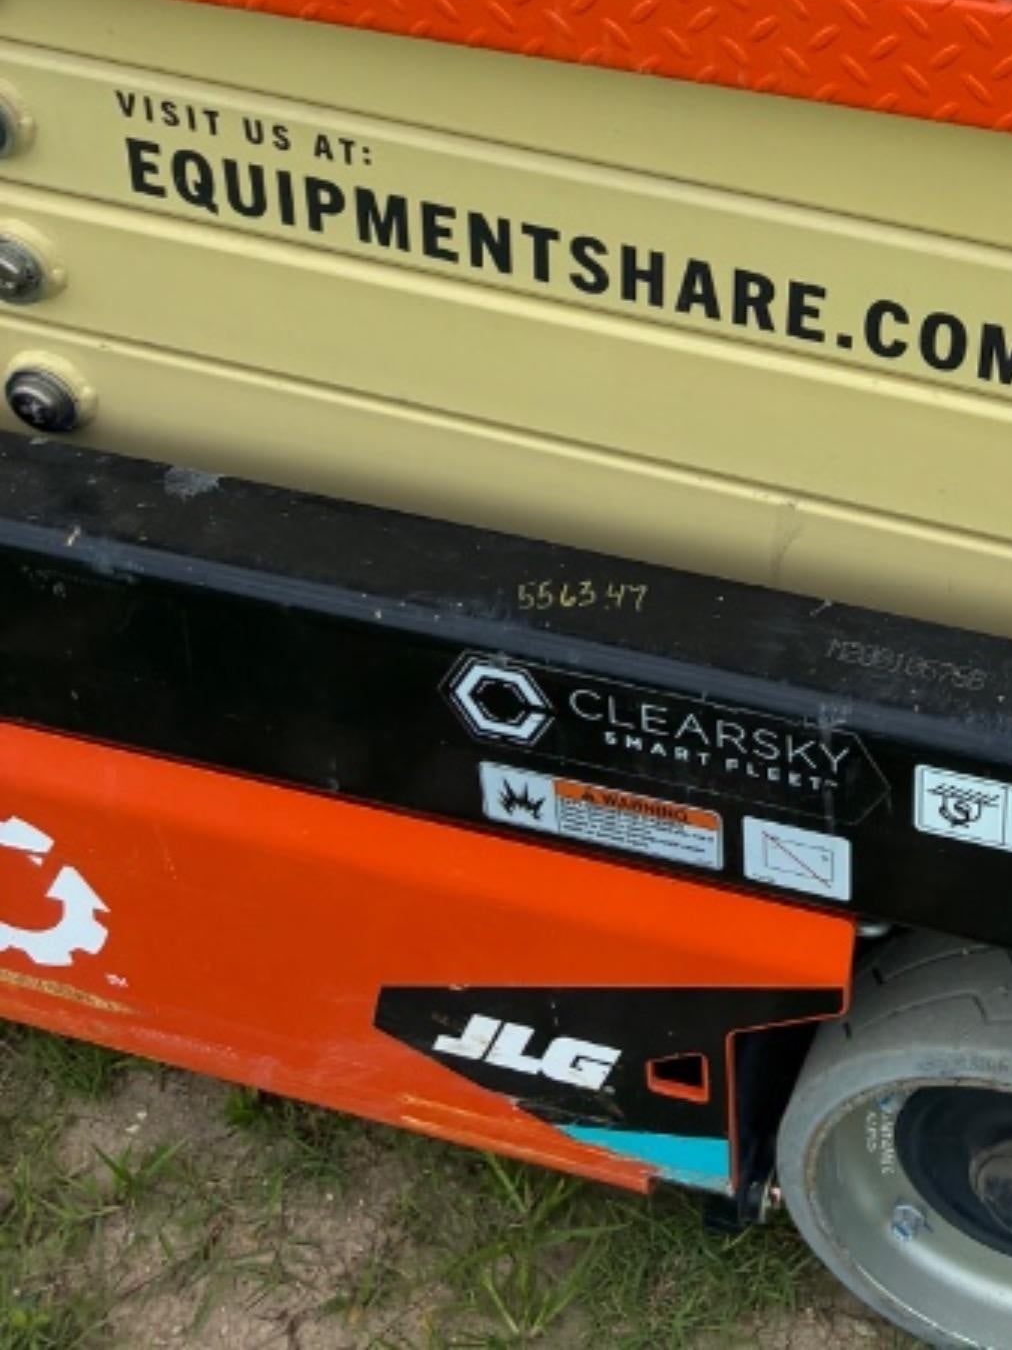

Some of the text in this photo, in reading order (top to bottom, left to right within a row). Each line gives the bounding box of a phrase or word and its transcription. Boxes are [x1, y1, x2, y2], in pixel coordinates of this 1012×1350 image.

[116, 90, 372, 166] VISIT US AT:
[569, 689, 849, 774] CLEARSKY
[603, 731, 711, 767] SMART
[603, 790, 689, 824] WARNING
[432, 1013, 622, 1091] JLG
